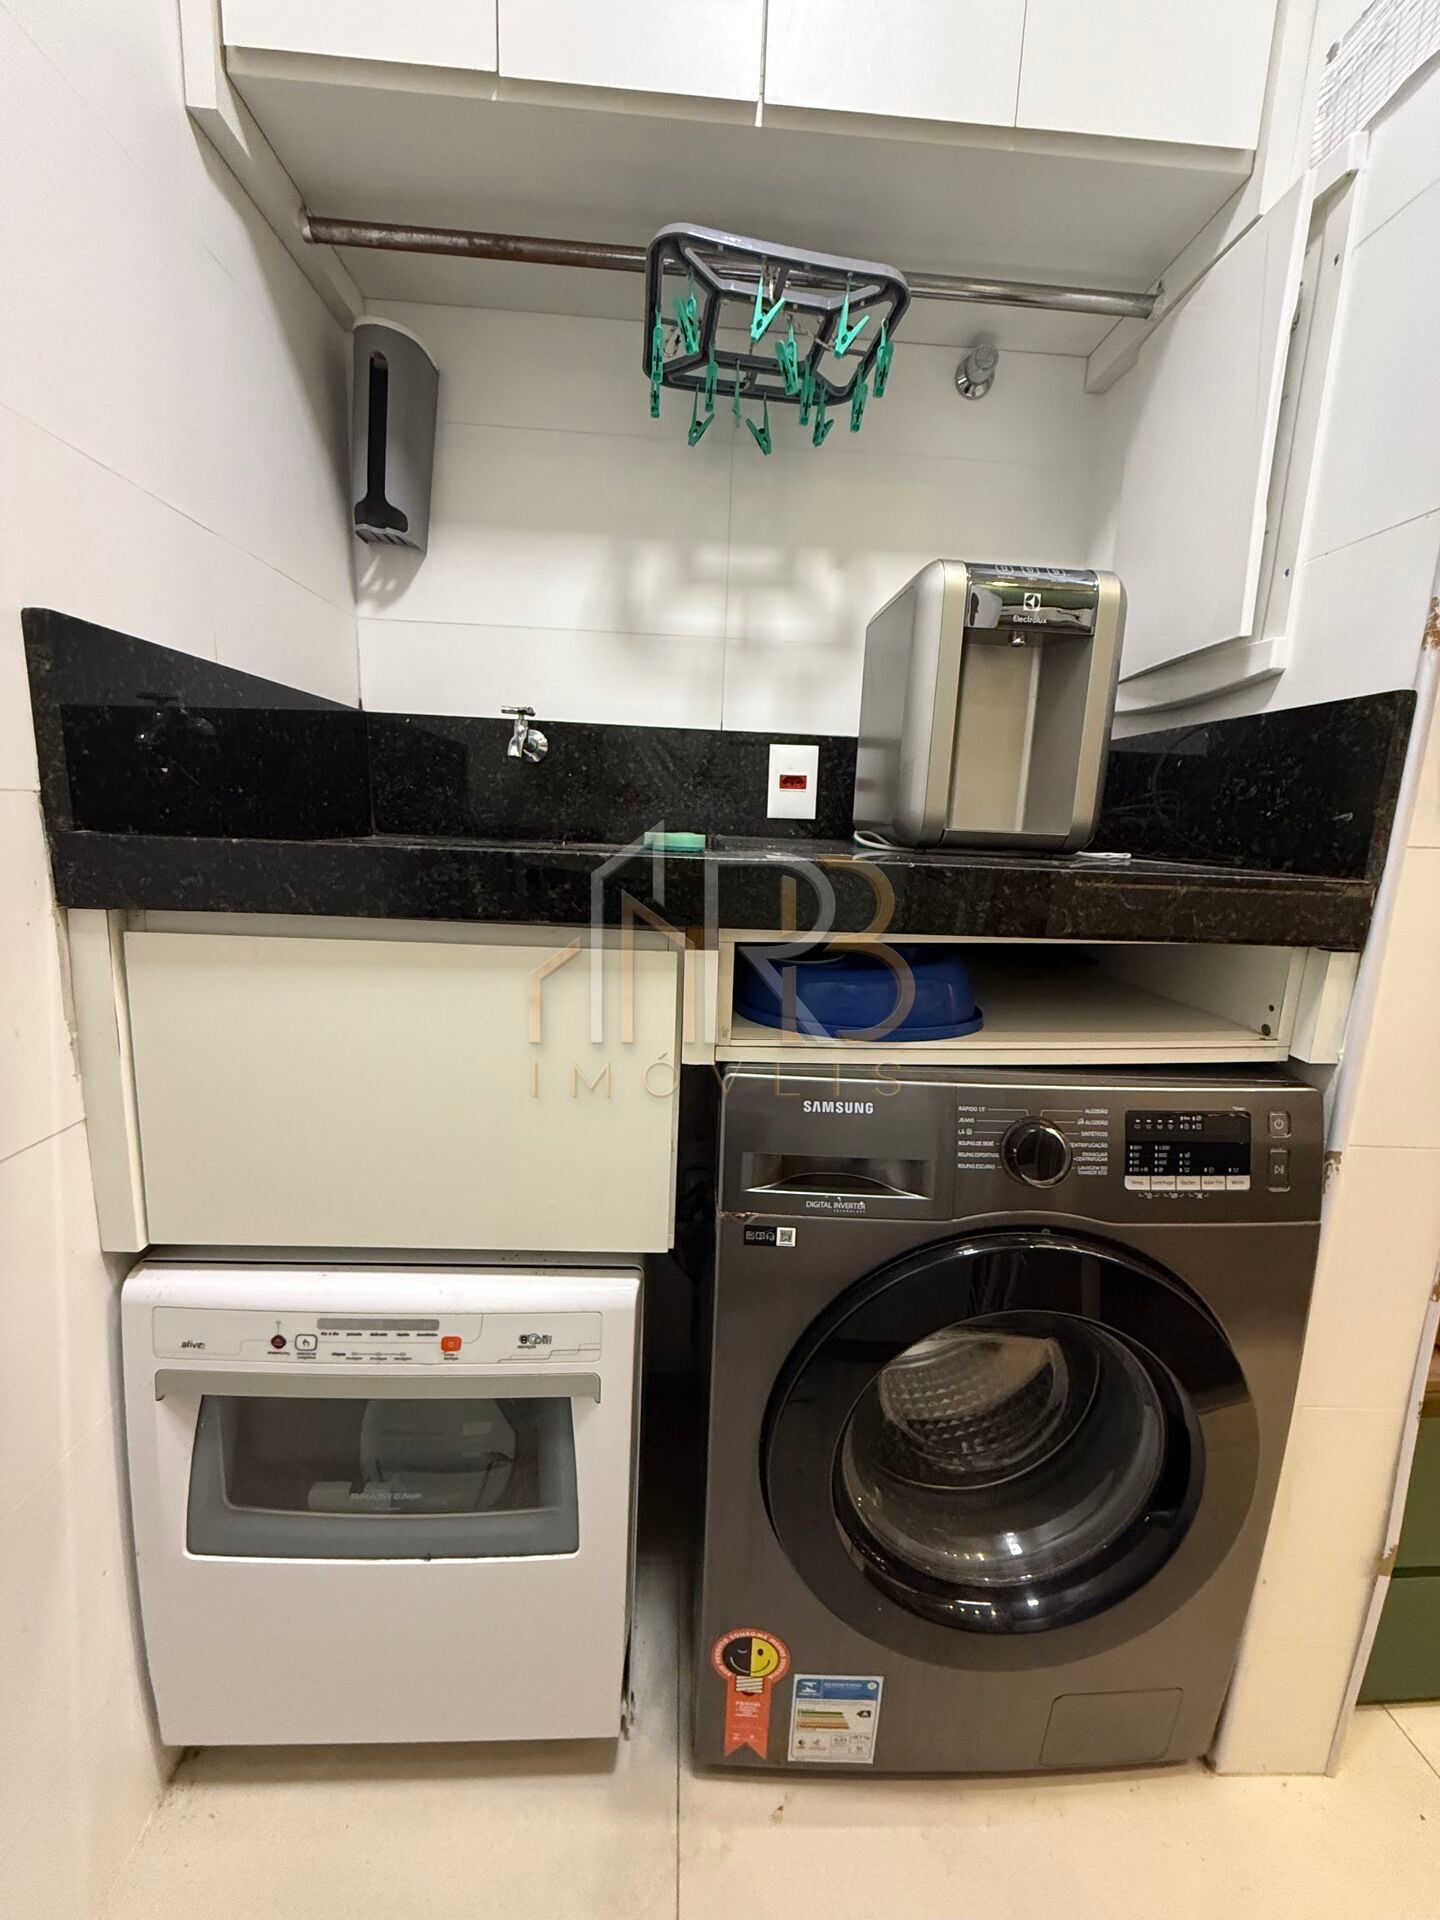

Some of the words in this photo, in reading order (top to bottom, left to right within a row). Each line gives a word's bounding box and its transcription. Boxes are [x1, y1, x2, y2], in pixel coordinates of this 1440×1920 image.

[1013, 615, 1047, 624] Electrolux
[803, 1100, 873, 1114] SAMSUNG
[806, 1200, 832, 1208] DIGITAL
[833, 1201, 866, 1210] INVERTER
